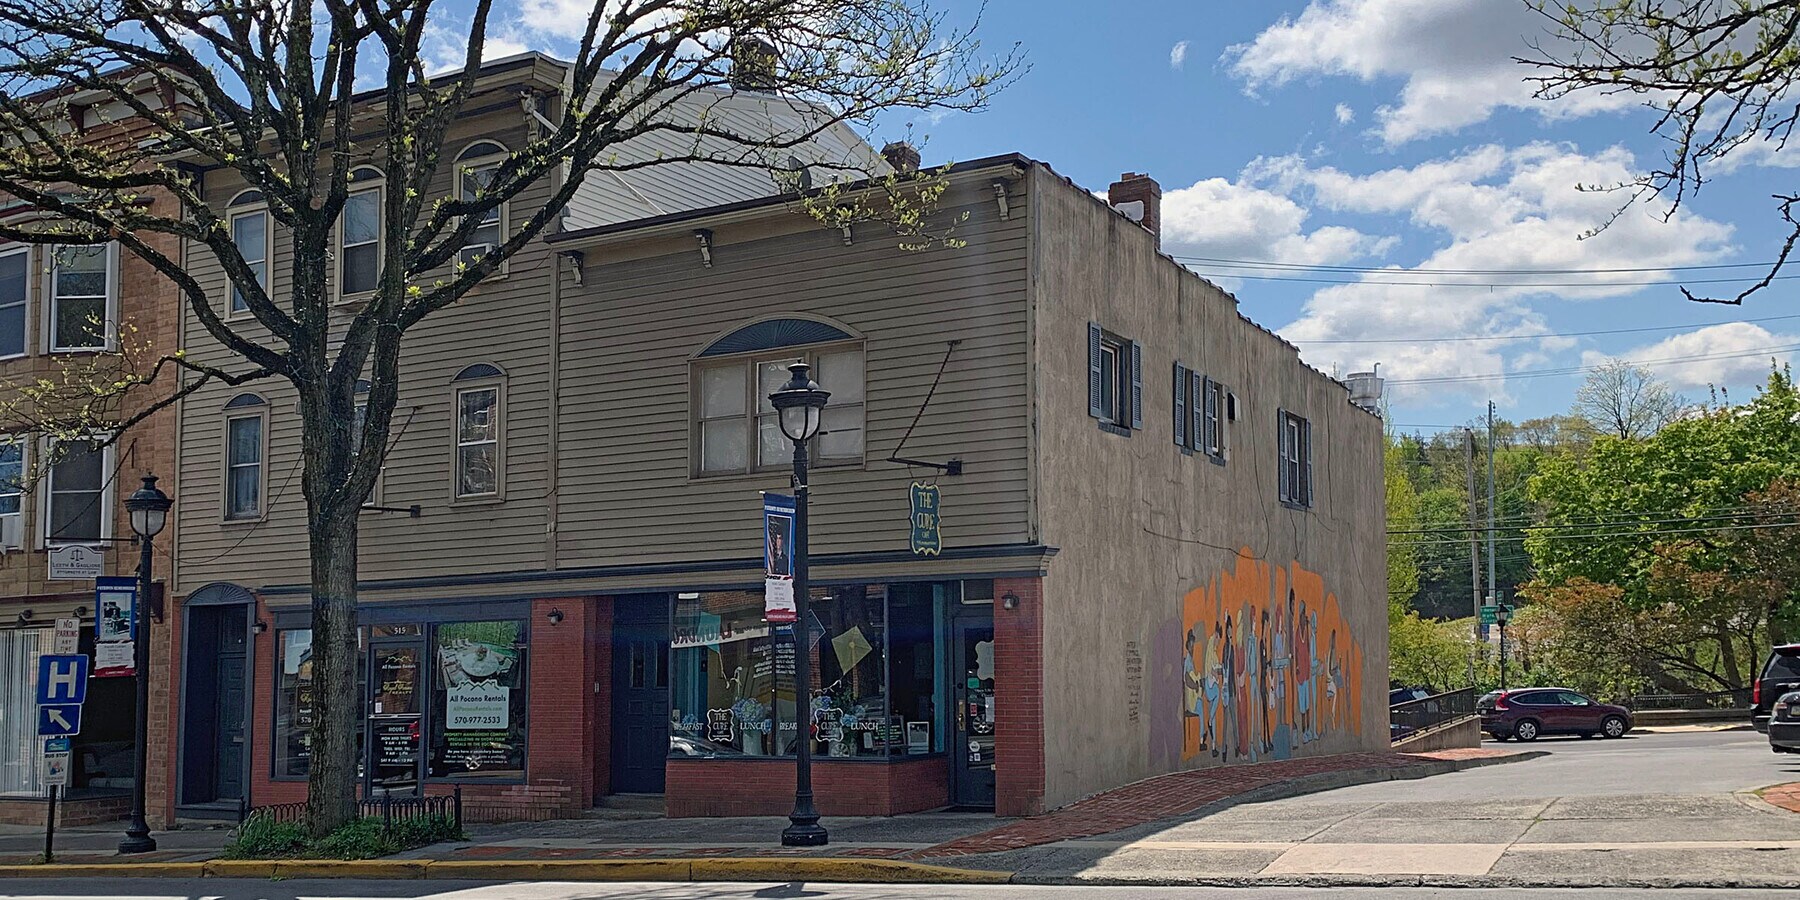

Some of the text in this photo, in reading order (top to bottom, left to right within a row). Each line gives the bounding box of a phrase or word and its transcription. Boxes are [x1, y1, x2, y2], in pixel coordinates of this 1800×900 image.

[918, 492, 933, 509] THE
[917, 512, 935, 530] CURE
[47, 661, 78, 699] H
[484, 694, 506, 702] Rentals
[454, 716, 501, 724] 570-977-2533
[714, 713, 727, 721] THE
[823, 712, 836, 720] THE
[712, 722, 729, 731] CURE
[740, 722, 766, 730] LUNCH
[821, 721, 838, 731] CURE
[851, 722, 878, 730] LUNCH
